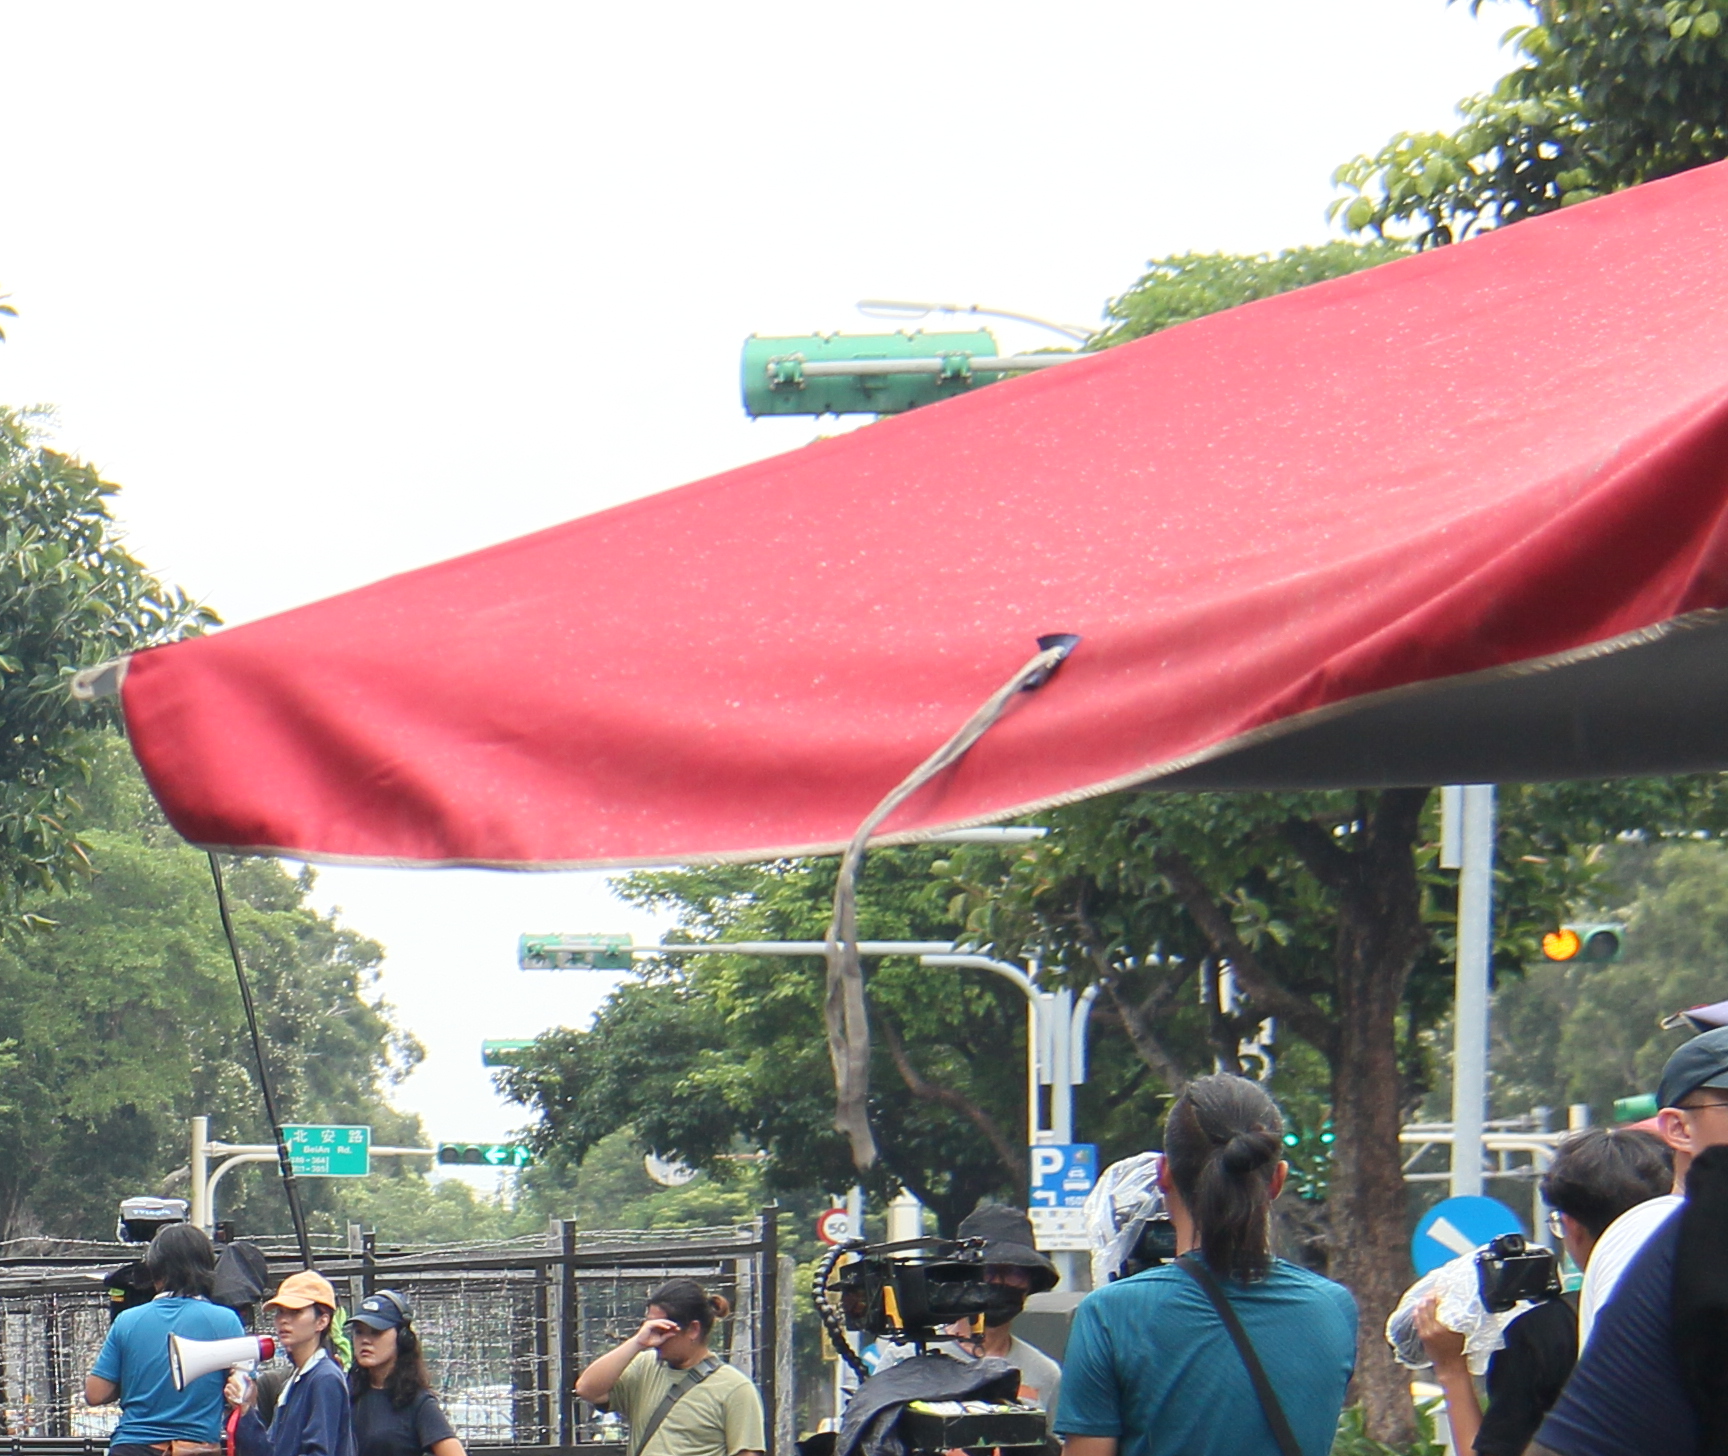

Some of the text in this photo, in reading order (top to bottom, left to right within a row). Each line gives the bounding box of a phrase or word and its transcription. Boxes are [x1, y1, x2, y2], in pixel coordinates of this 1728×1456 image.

[292, 1129, 364, 1144] 北安路
[337, 1145, 352, 1154] Rd.
[1031, 1147, 1065, 1188] P
[827, 1221, 849, 1236] 50
